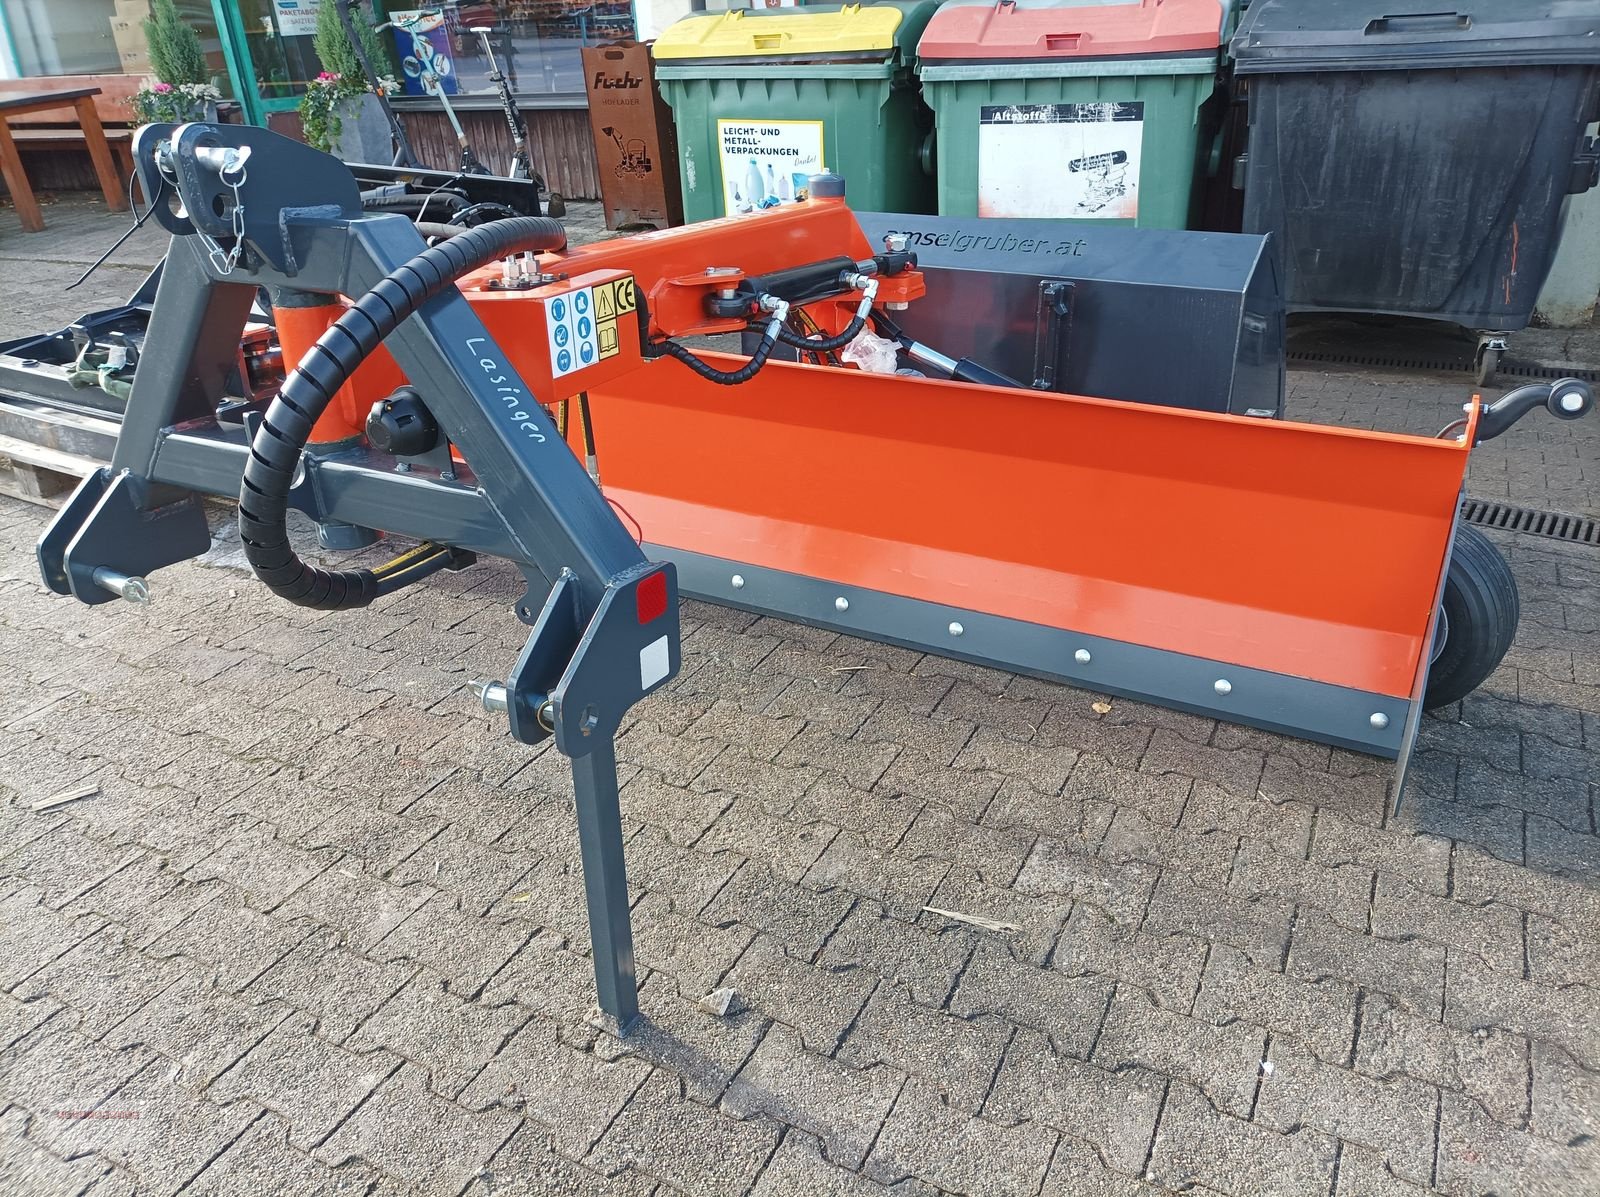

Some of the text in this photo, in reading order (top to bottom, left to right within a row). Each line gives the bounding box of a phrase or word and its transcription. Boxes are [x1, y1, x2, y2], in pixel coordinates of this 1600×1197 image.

[602, 98, 640, 106] HOFLADER
[723, 127, 781, 136] LEICHT- UND
[724, 137, 761, 145] METALL-
[725, 146, 799, 156] VERPACKUNGEN
[465, 337, 546, 443] Lasinger
